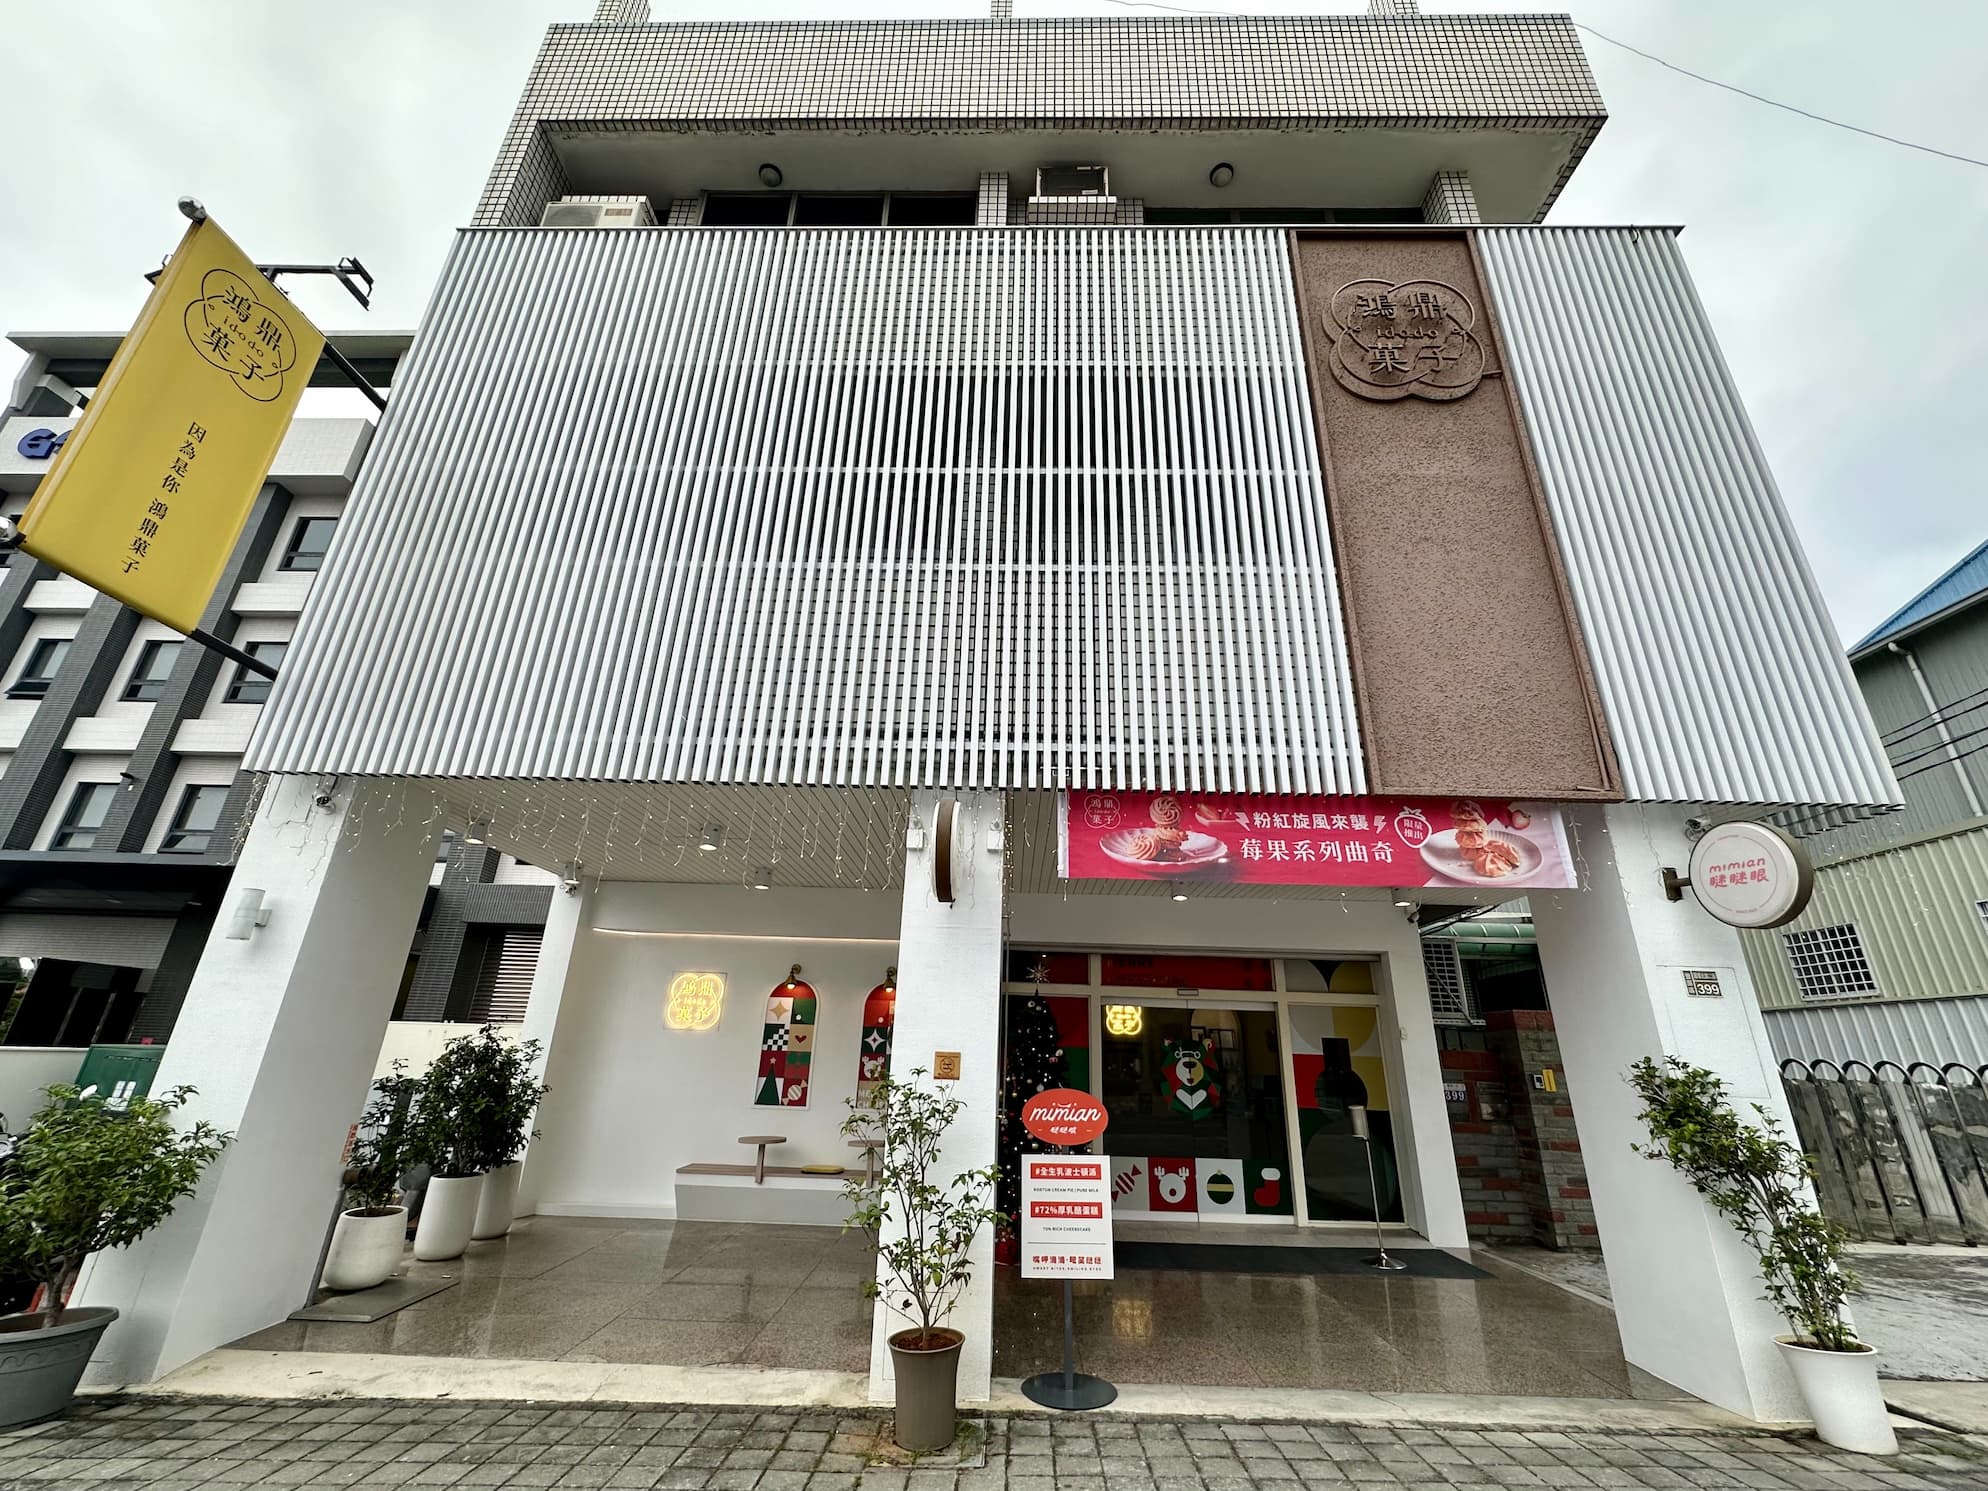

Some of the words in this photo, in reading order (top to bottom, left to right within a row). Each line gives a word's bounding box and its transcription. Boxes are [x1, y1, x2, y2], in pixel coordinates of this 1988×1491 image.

[1355, 291, 1446, 320] 鴻鼎
[200, 322, 265, 382] 菓子
[1368, 342, 1458, 375] 菓子
[160, 421, 207, 494] 因為是你
[121, 498, 168, 574] 鴻鼎菓子
[1253, 812, 1370, 831] 粉紅旋風來襲
[1240, 838, 1394, 863] 莓果系列曲奇
[1709, 858, 1765, 873] mimian
[1697, 984, 1719, 995] 399
[1446, 1090, 1465, 1101] 399
[1029, 1102, 1101, 1122] mimian
